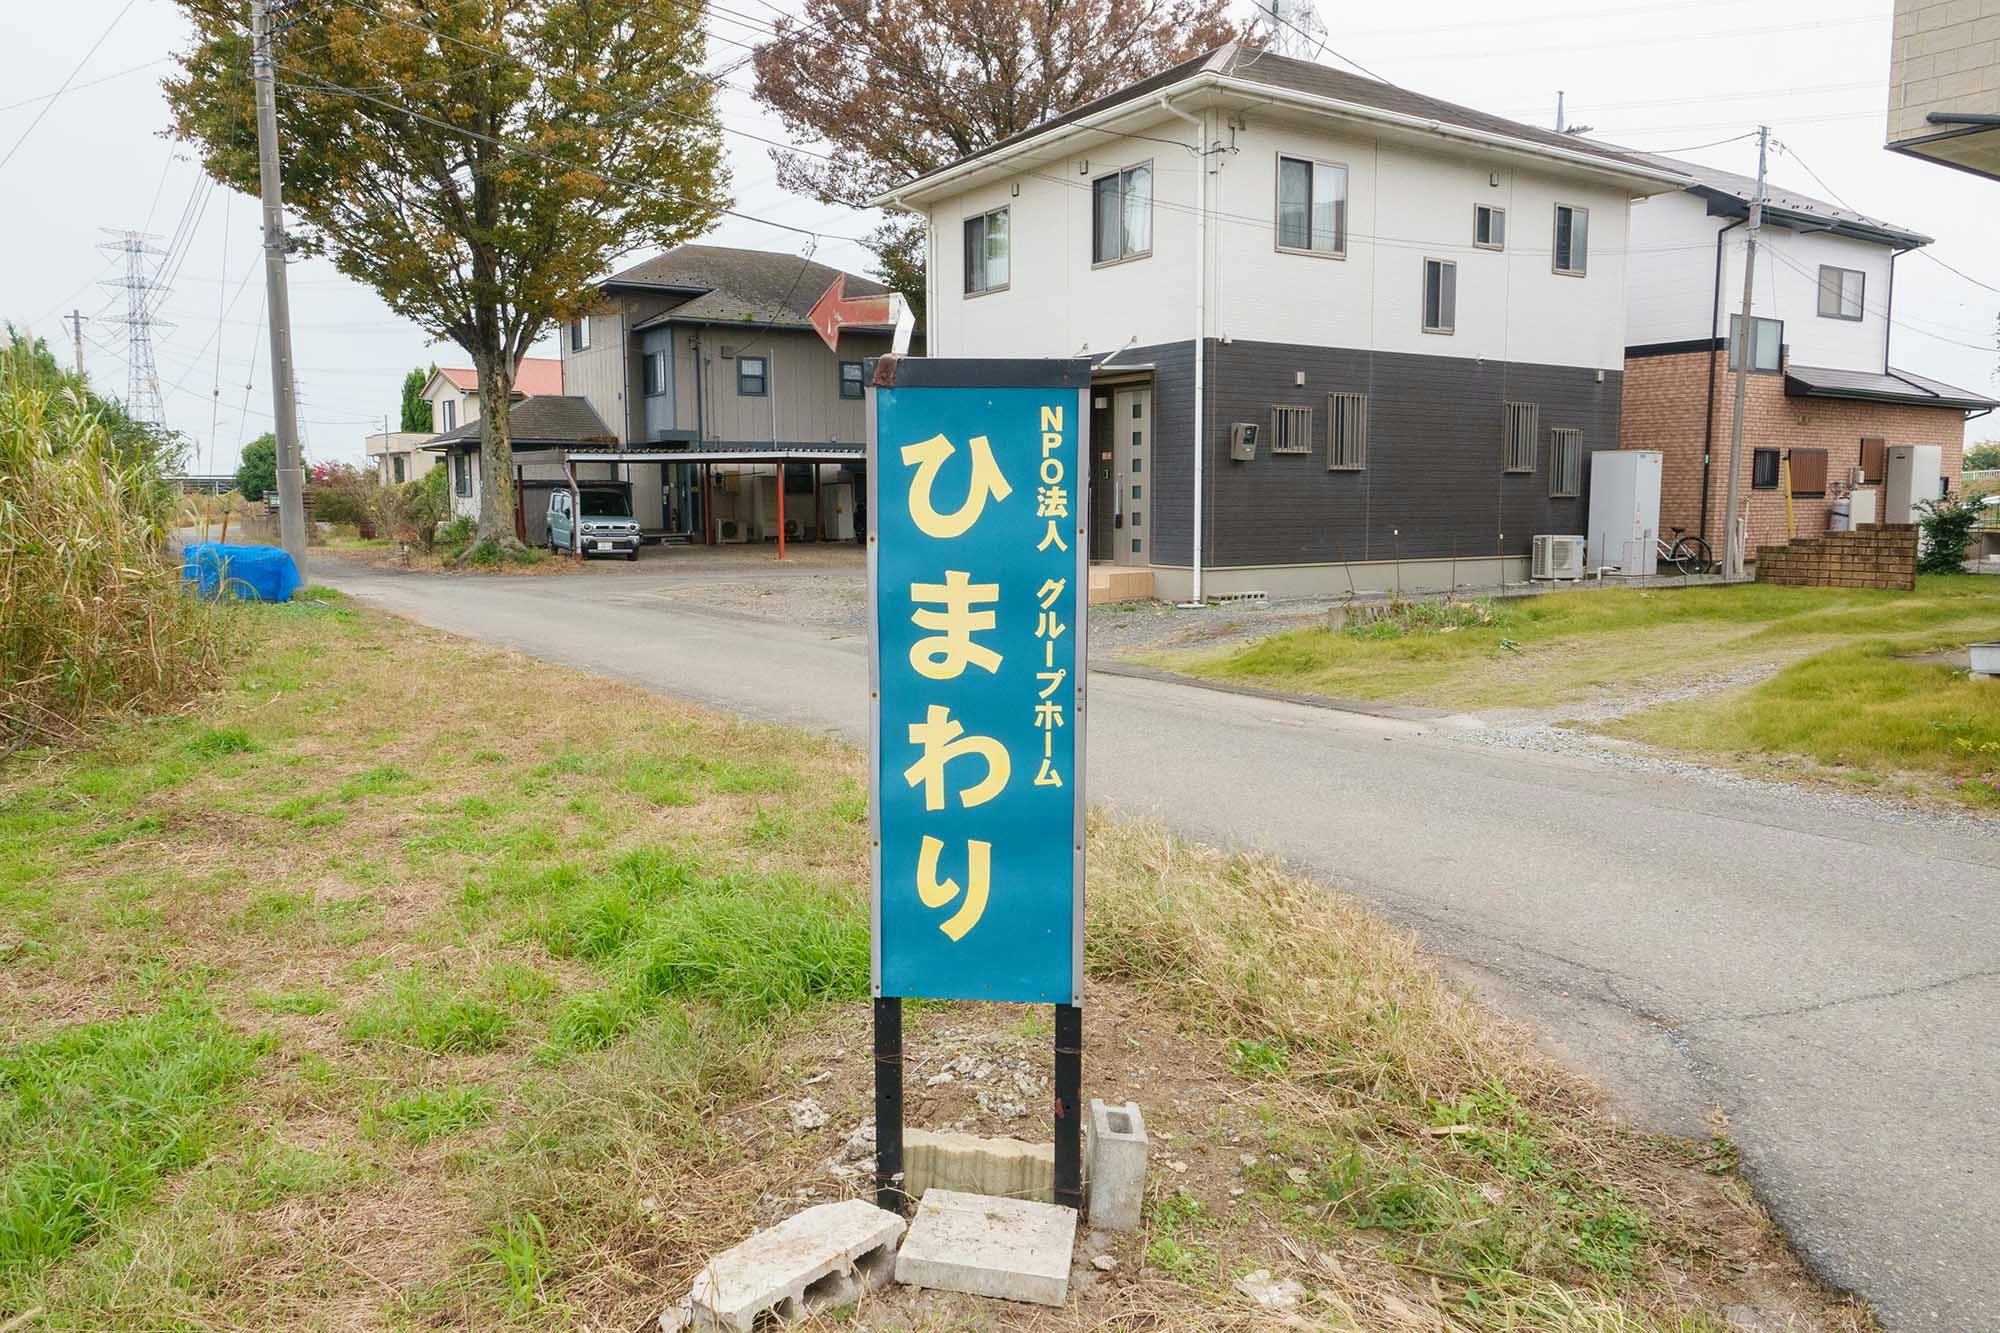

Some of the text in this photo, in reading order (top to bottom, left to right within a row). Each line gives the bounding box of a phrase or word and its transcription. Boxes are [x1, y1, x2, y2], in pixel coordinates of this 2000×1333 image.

[900, 433, 1013, 942] ひまわり
[1034, 405, 1069, 788] NPO法人 グループホーム
